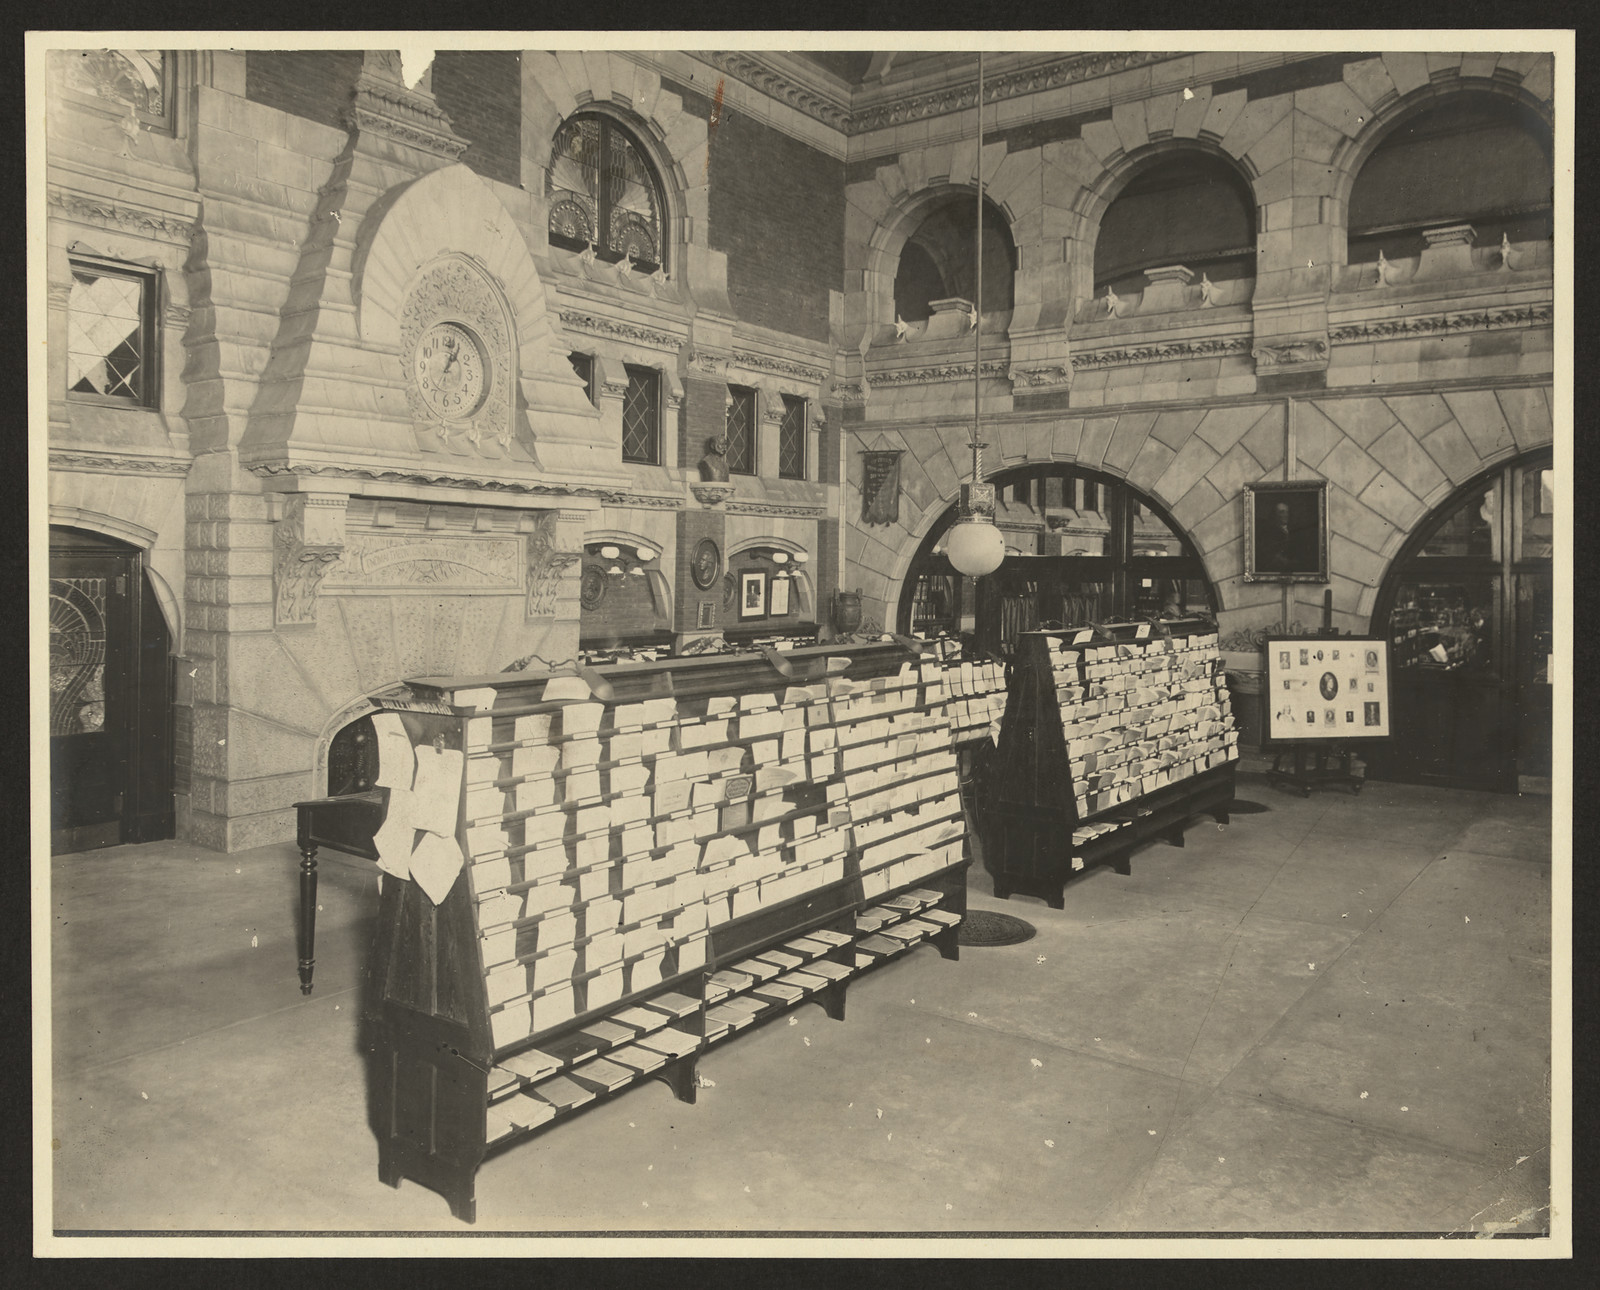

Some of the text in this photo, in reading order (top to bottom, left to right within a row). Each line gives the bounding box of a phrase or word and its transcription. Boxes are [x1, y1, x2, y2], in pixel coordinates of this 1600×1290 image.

[432, 338, 439, 349] 11
[423, 347, 432, 359] 10
[463, 354, 470, 367] 2
[419, 361, 426, 374] 9
[465, 370, 473, 382] 3
[422, 377, 429, 389] 8
[430, 389, 438, 403] 7
[461, 384, 469, 396] 4
[442, 394, 449, 407] 6
[453, 393, 461, 404] 5
